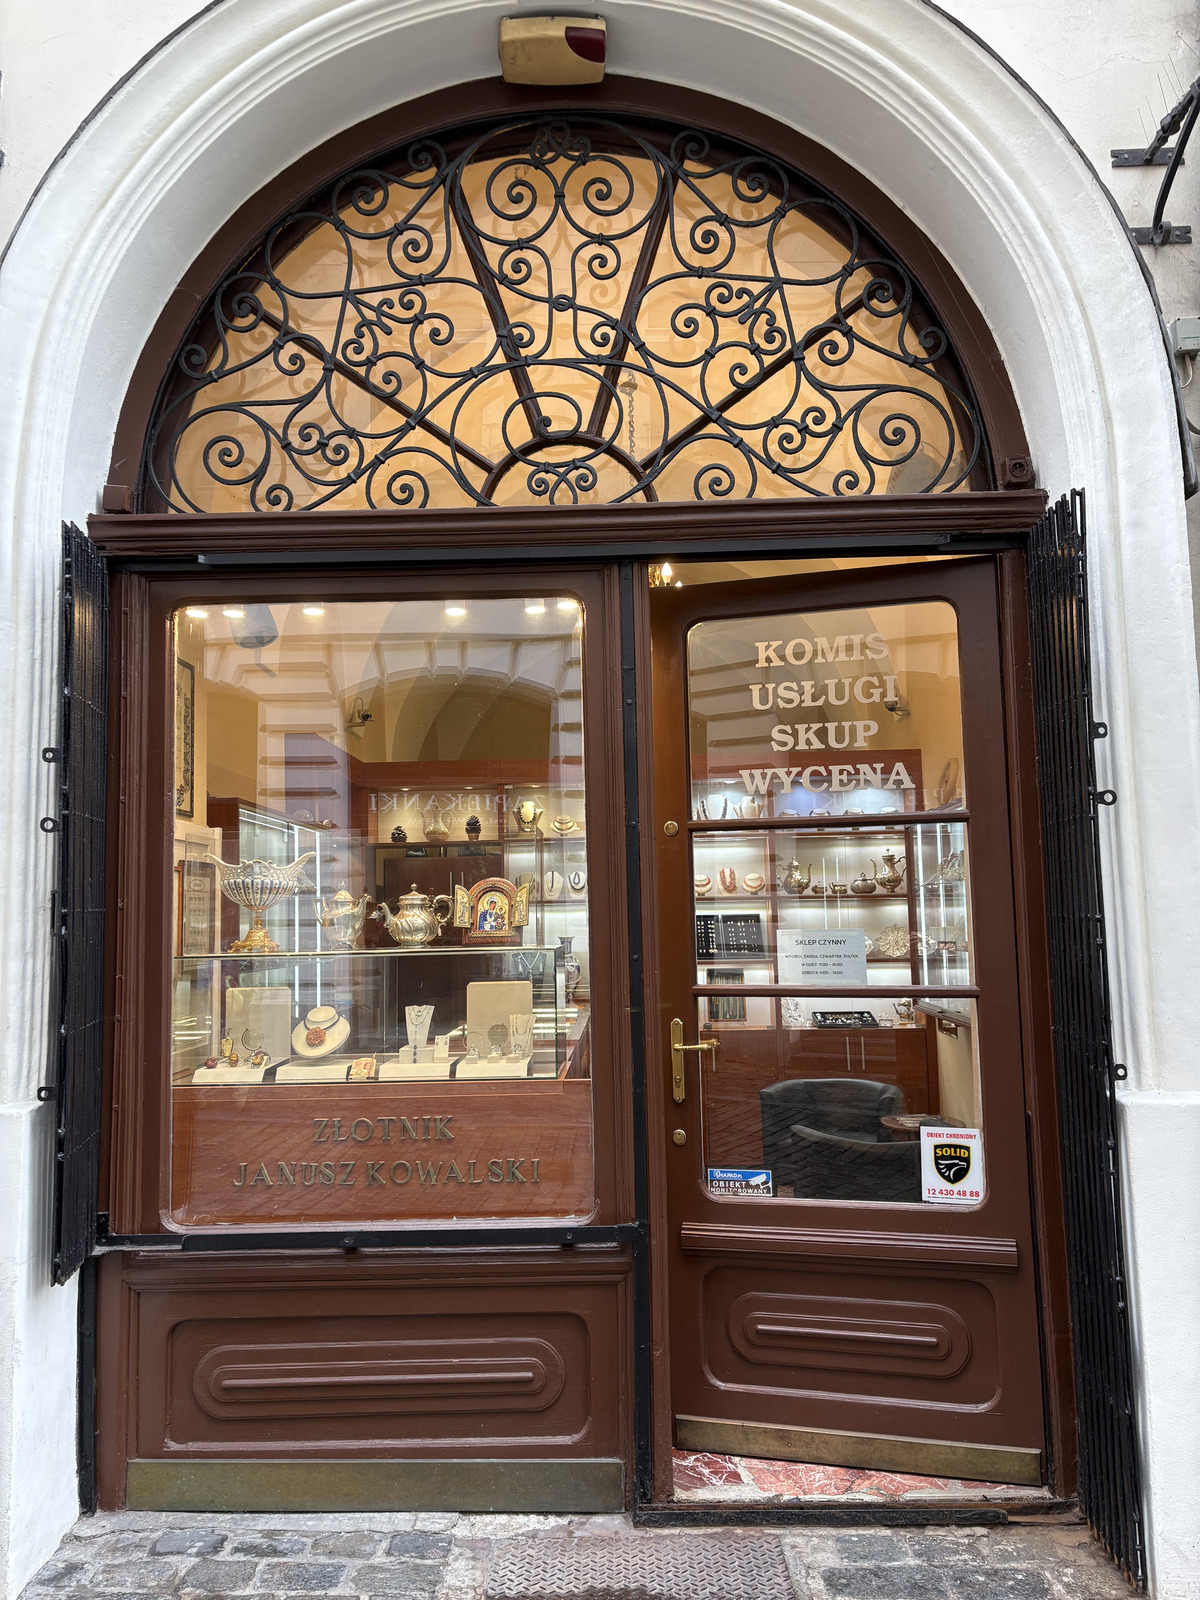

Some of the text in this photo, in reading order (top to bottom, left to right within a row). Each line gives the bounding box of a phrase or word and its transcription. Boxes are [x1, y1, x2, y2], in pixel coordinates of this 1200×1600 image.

[754, 632, 890, 668] KOMIS
[749, 675, 898, 710] USŁUGI
[770, 720, 879, 751] SKUP
[739, 762, 915, 795] WYCENA
[312, 1116, 455, 1142] ZŁOTNIK
[935, 1147, 969, 1158] SOLID
[233, 1158, 540, 1187] JANUSZ KOWALSKI
[712, 1180, 747, 1188] OBIEKT
[969, 1190, 980, 1198] 88
